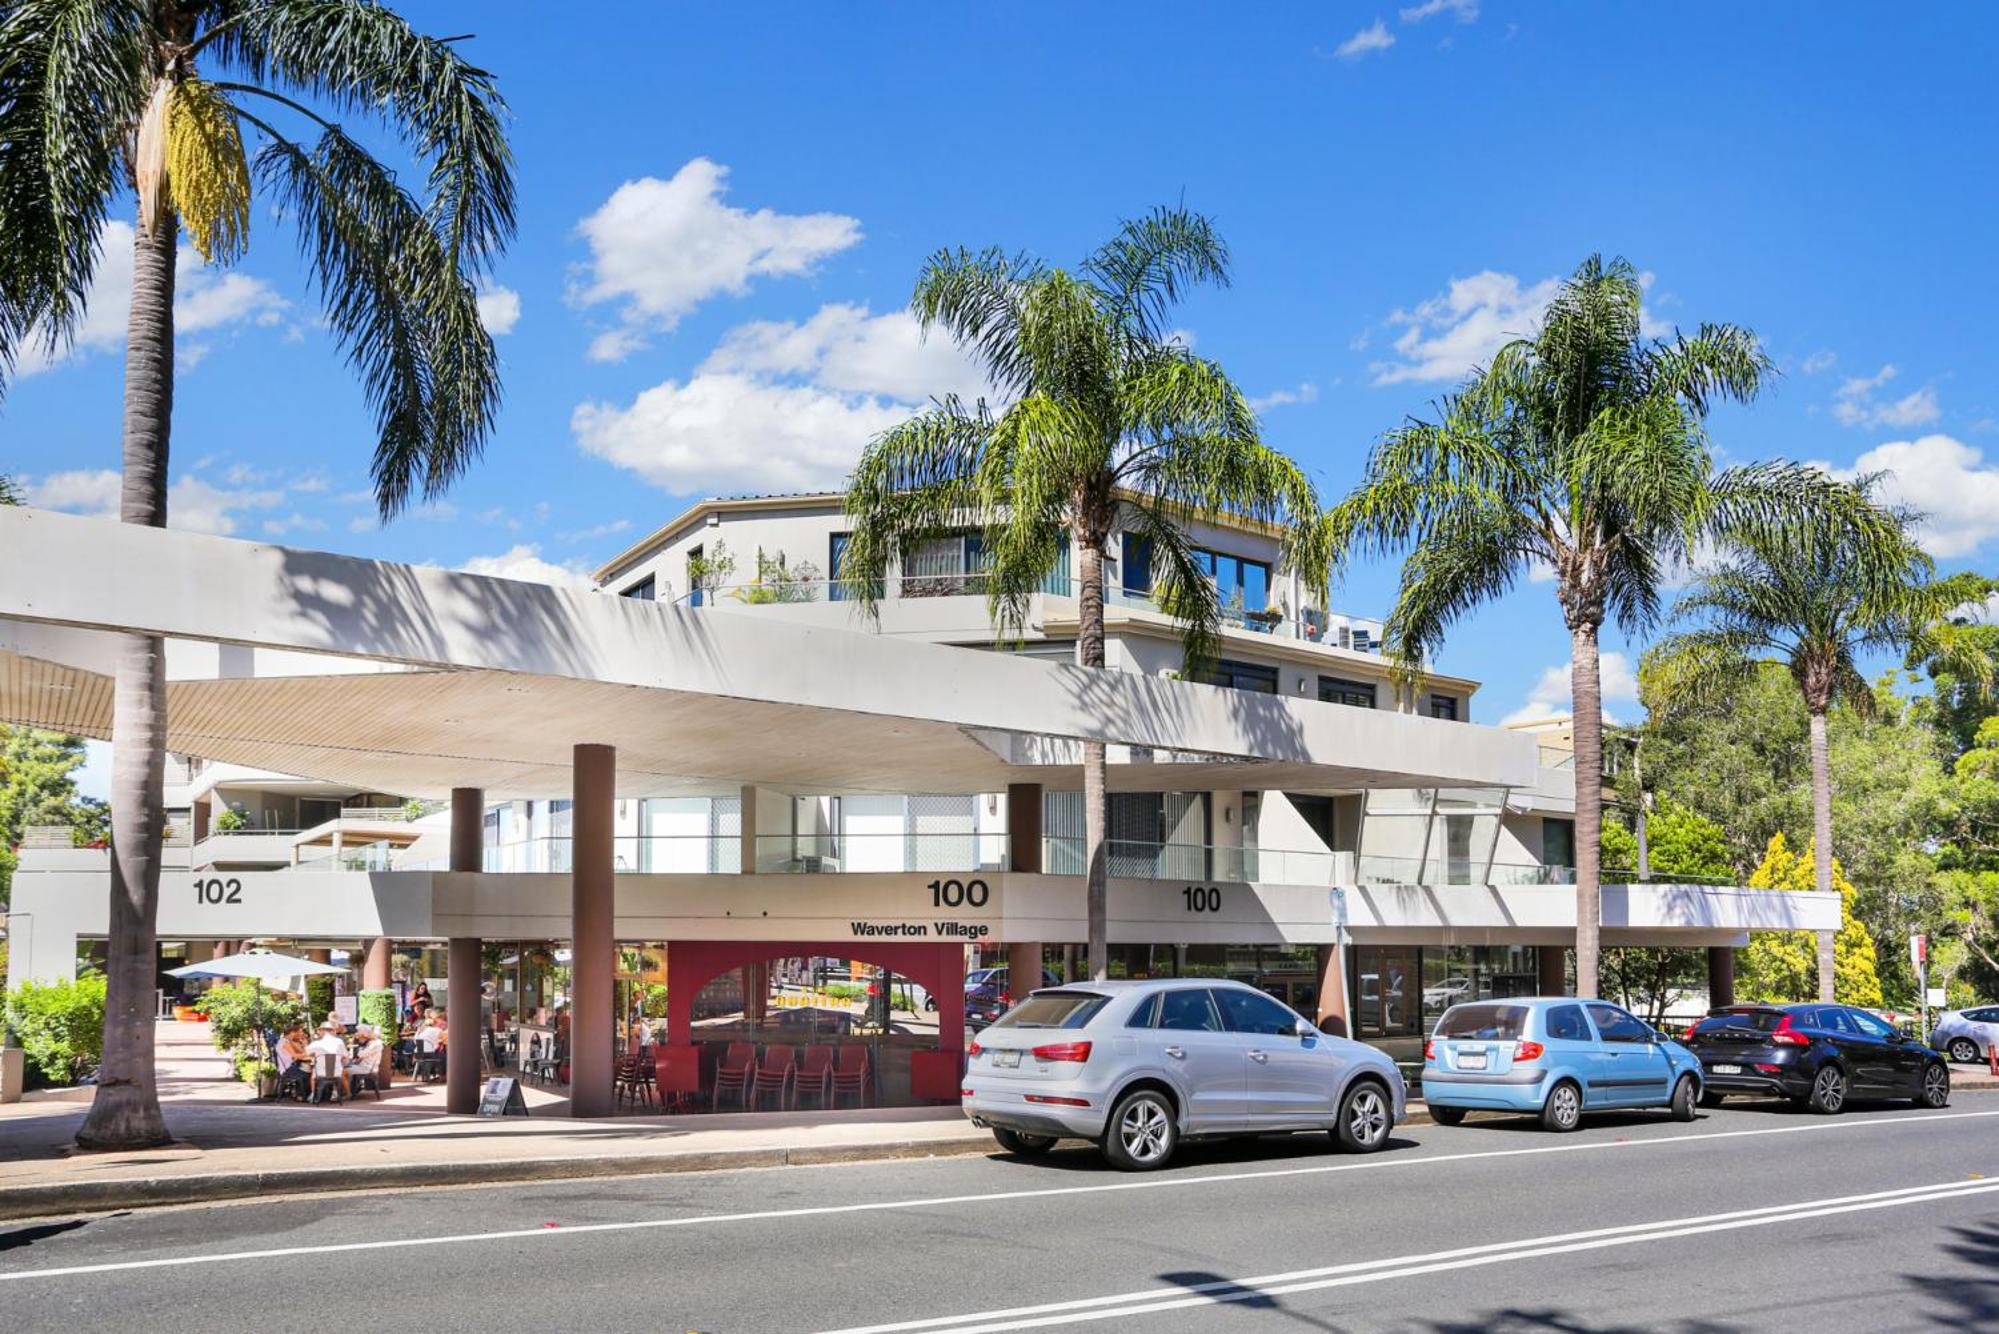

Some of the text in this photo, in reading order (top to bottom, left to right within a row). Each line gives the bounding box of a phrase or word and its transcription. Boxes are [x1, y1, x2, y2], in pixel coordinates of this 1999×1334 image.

[193, 878, 242, 904] 102
[927, 879, 989, 907] 100
[1182, 886, 1221, 912] 100
[851, 921, 989, 939] Waverton Village
